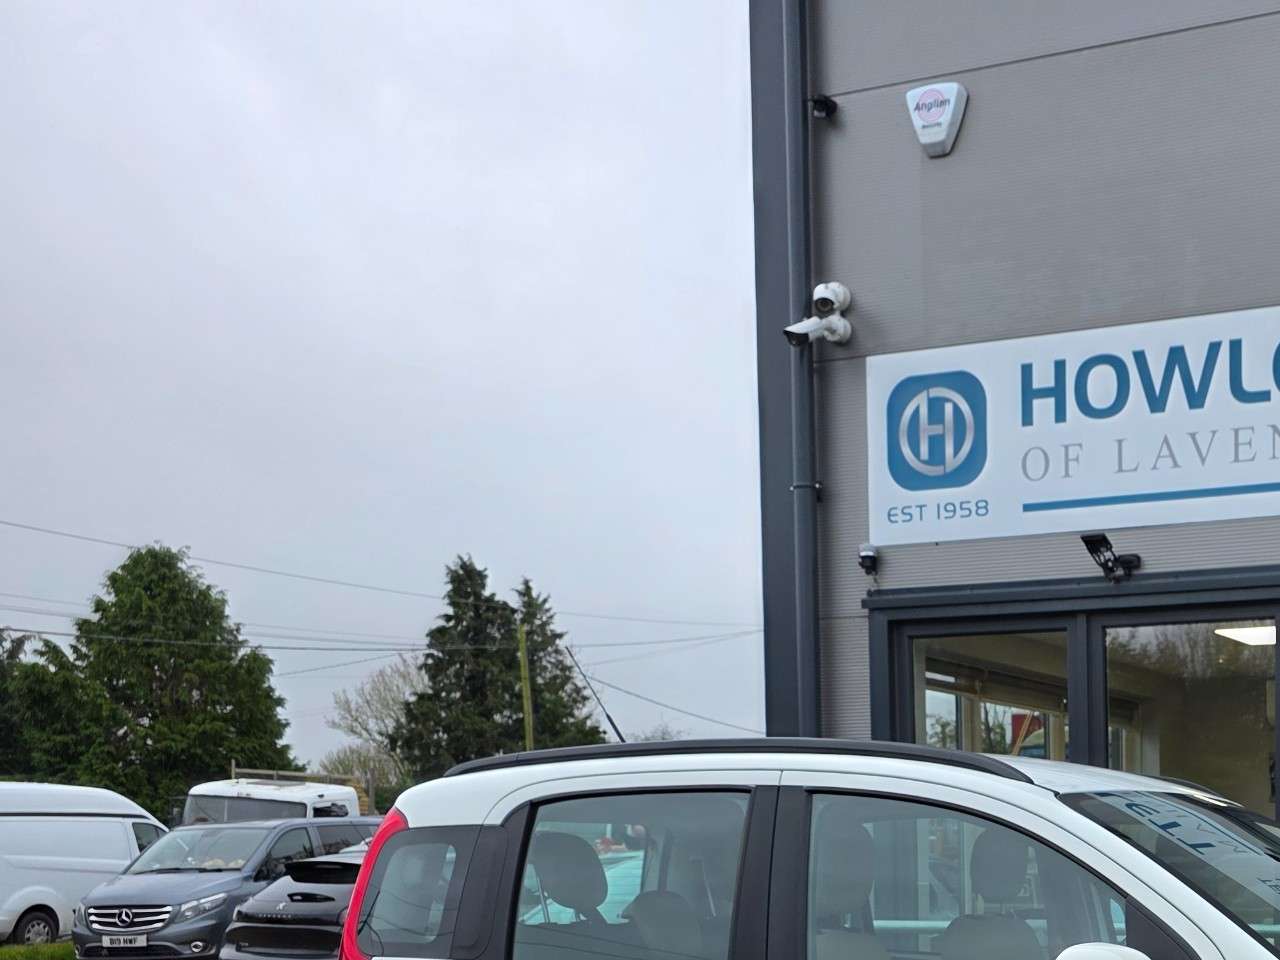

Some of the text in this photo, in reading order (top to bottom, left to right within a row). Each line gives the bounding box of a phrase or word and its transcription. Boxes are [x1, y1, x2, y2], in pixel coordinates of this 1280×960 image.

[1020, 443, 1083, 482] OF
[886, 499, 990, 524] EST 1958
